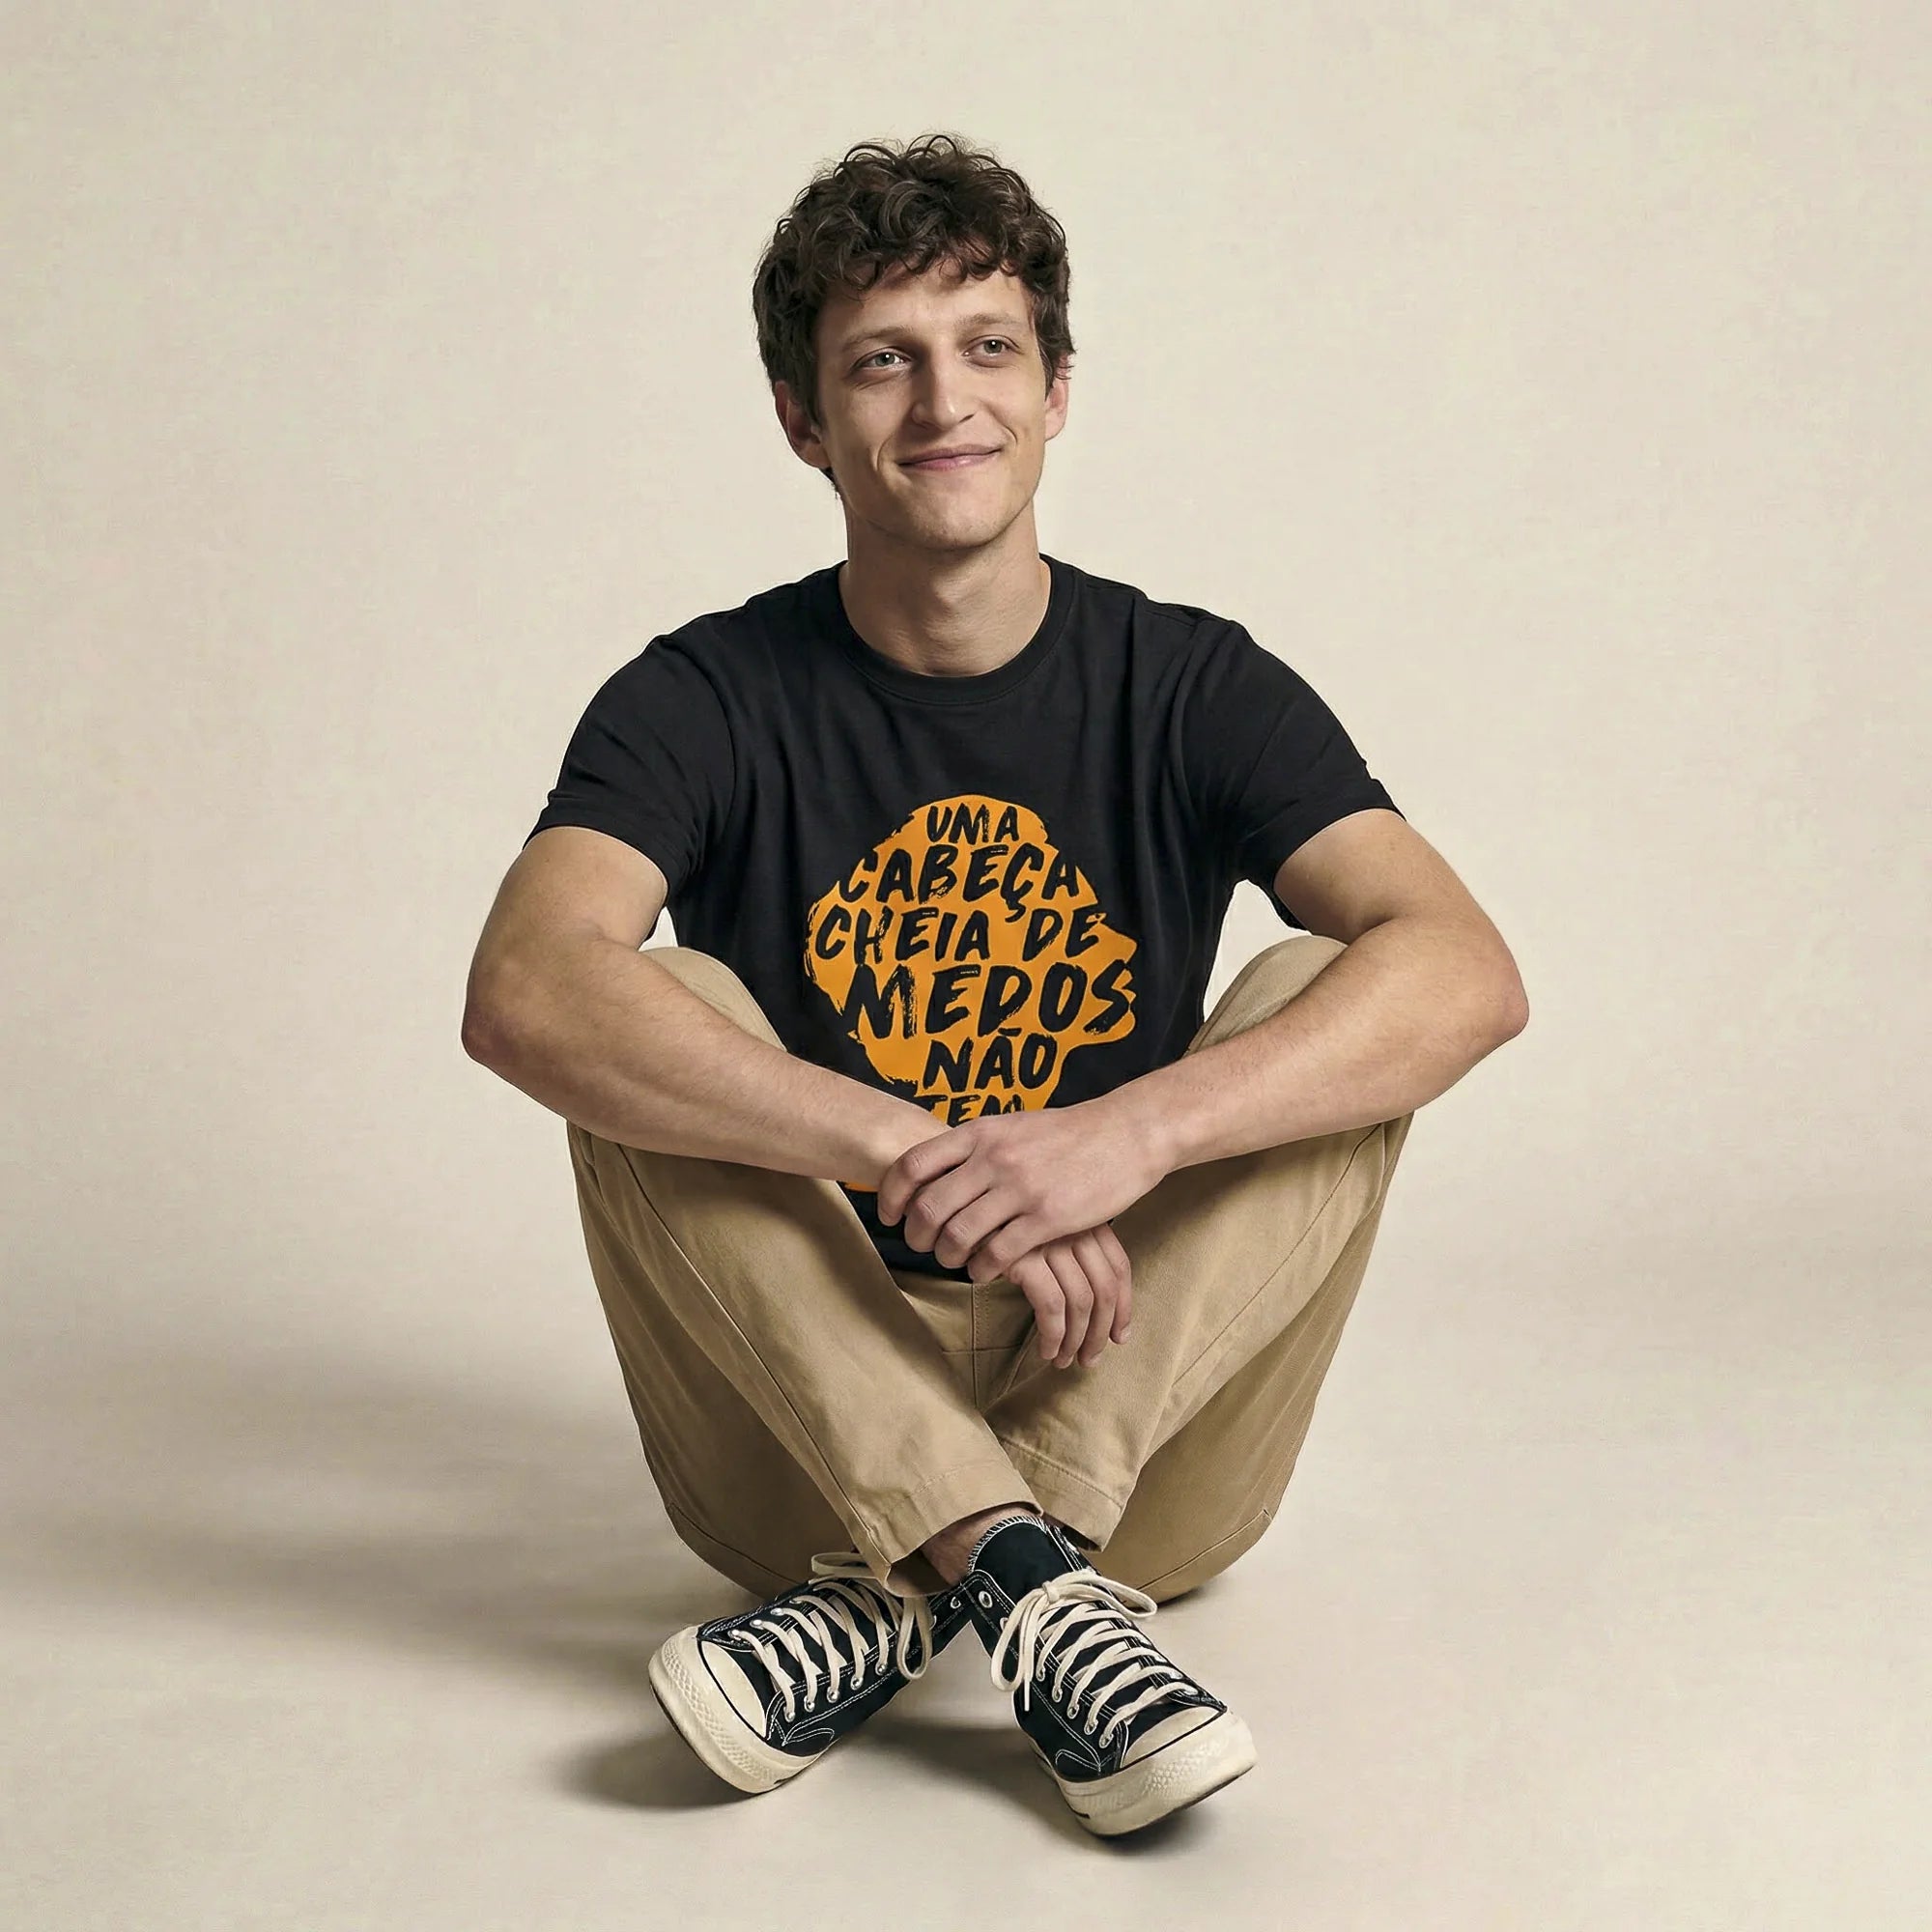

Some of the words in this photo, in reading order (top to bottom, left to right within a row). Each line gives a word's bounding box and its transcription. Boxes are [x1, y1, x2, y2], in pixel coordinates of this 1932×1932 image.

[926, 803, 1020, 844] UMA
[838, 842, 1081, 922] CABEÇA
[814, 904, 991, 964] CHEIA
[1021, 904, 1105, 959] DE
[842, 960, 1135, 1037] MEDOS
[923, 1028, 1059, 1093] NÃO
